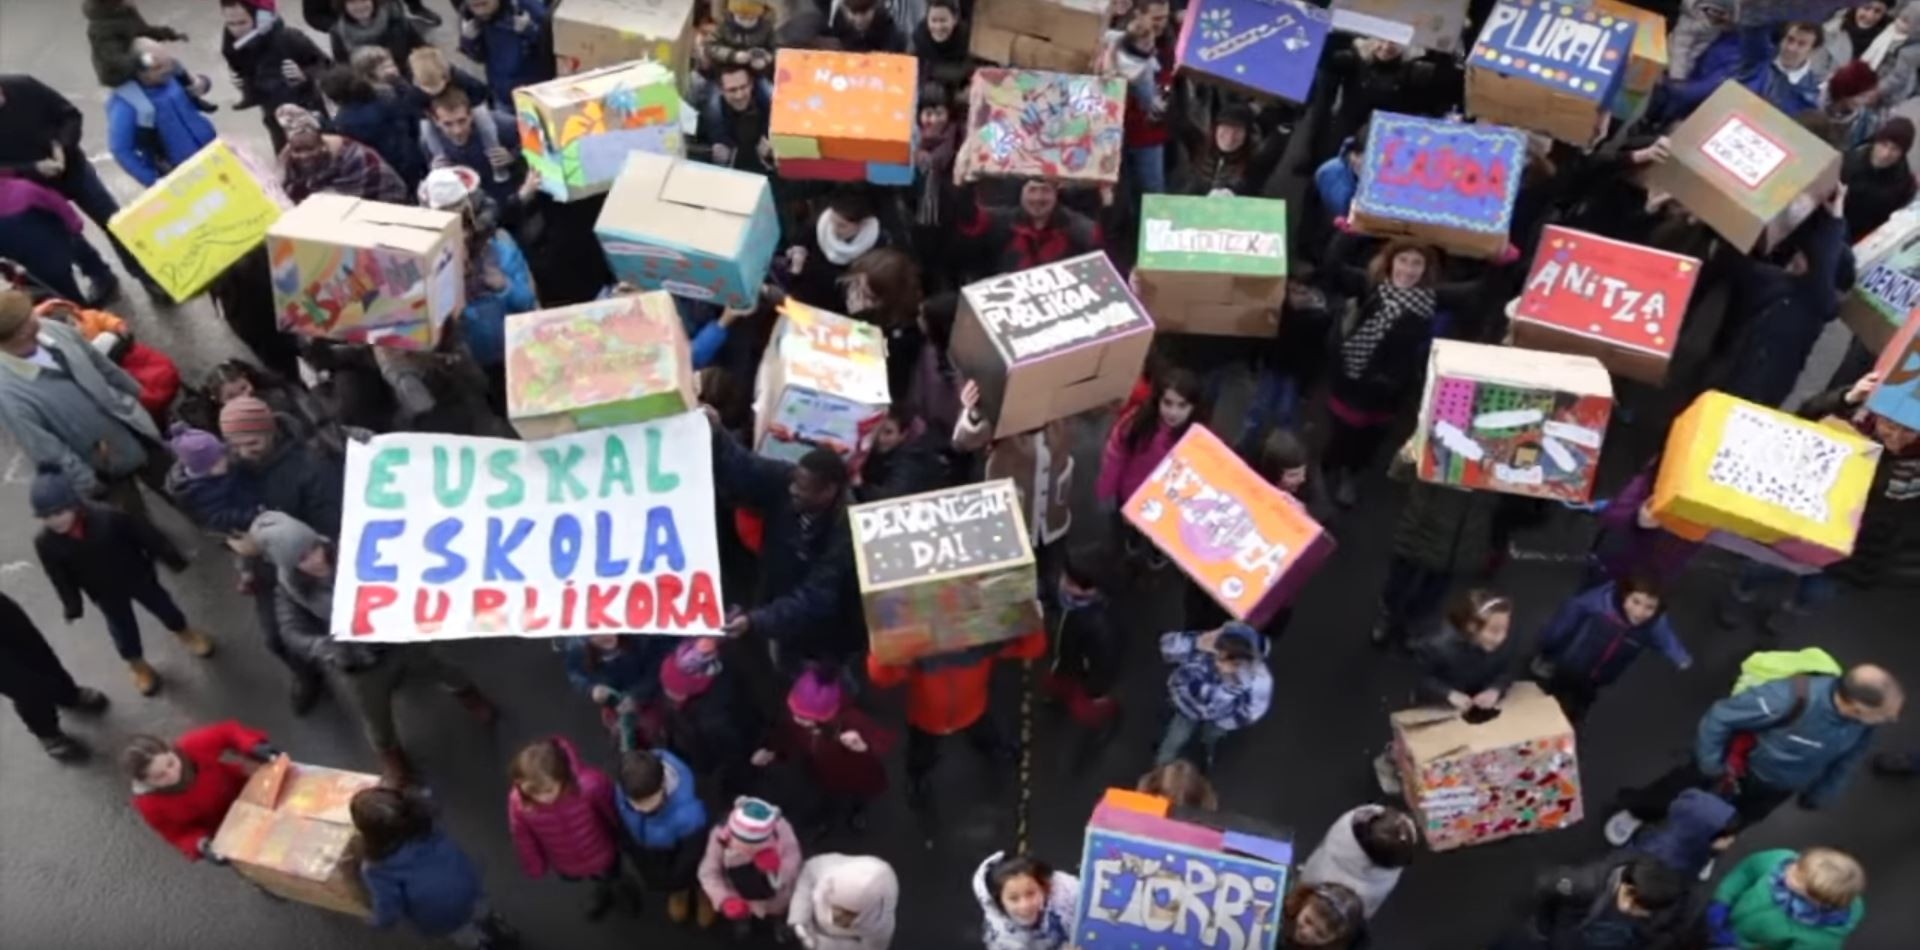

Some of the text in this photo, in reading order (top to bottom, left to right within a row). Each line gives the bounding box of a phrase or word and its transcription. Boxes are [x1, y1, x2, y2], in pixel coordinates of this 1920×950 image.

[1482, 5, 1612, 75] PLURAL
[970, 266, 1079, 304] ESKOLA
[364, 428, 680, 509] EUSKAL
[355, 505, 686, 583] ESKOLA
[860, 489, 1012, 544] DENONTZAT
